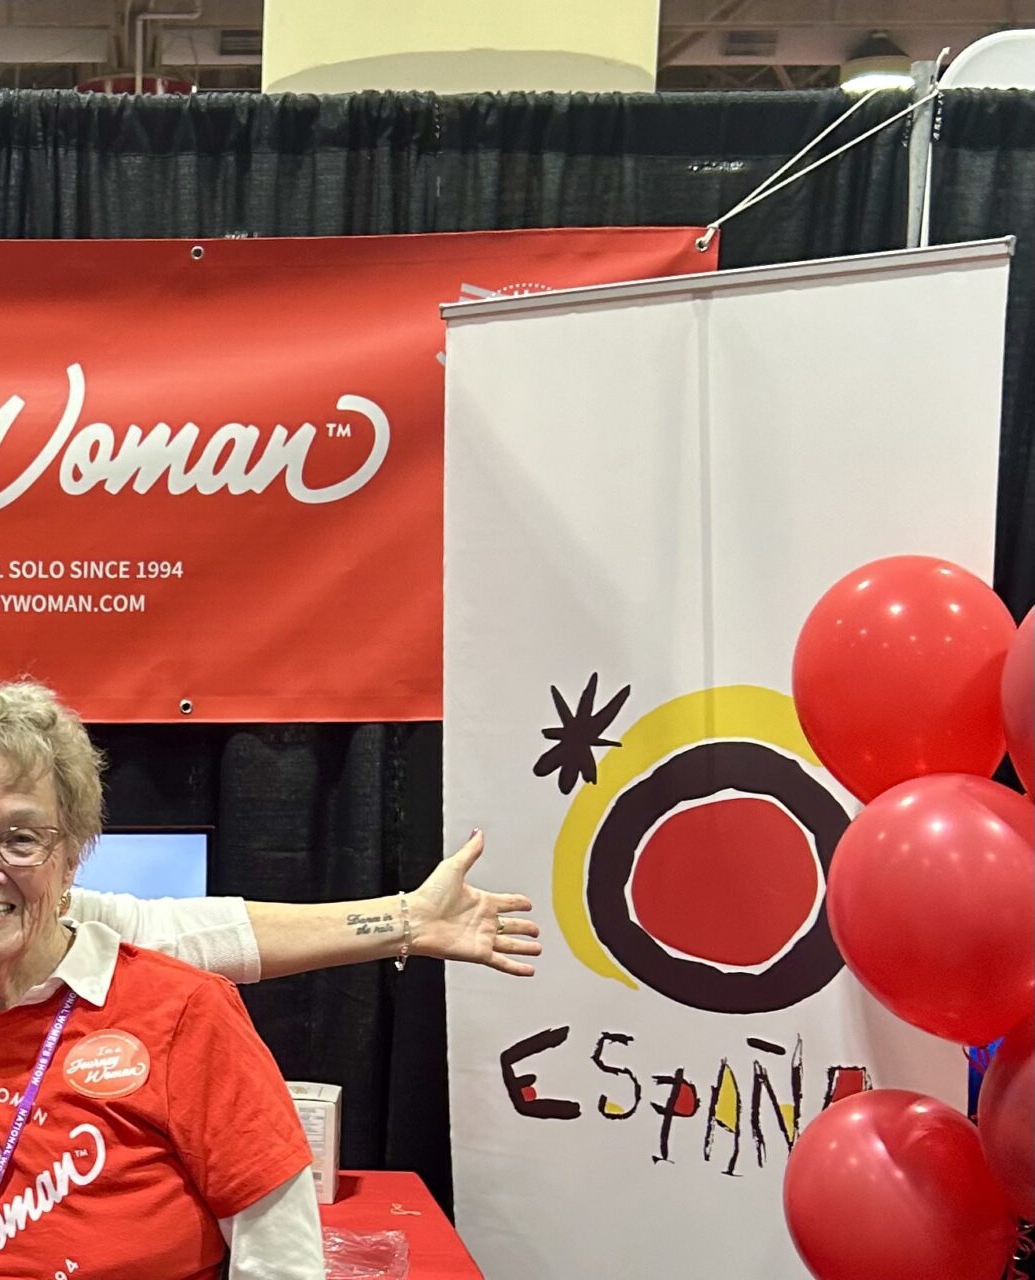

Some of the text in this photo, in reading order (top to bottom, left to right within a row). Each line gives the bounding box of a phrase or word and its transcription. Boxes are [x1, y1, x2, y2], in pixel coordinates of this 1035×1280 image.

[9, 561, 65, 579] SOLO
[70, 561, 130, 579] SINCE
[136, 561, 184, 579] 1994
